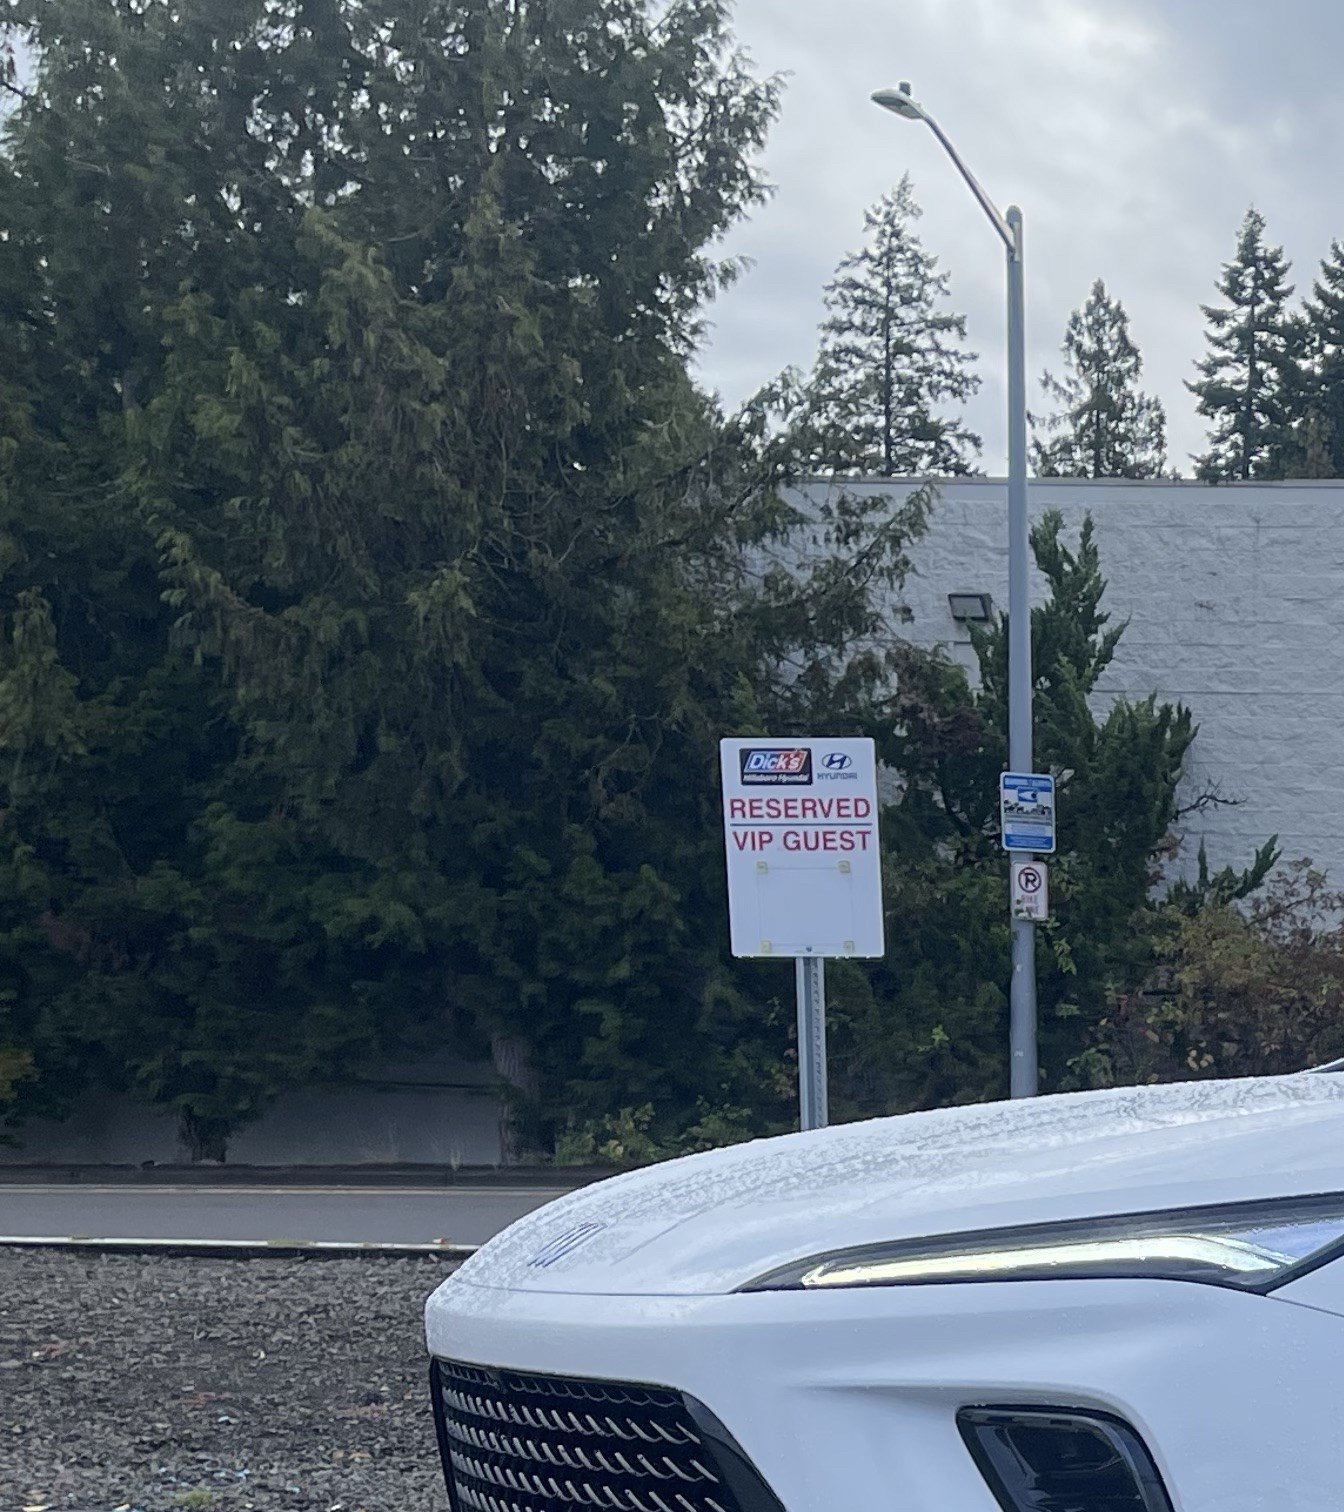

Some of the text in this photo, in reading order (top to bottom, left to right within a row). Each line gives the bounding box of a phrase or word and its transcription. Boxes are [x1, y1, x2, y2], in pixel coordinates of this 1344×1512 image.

[749, 752, 802, 771] Dick's
[816, 771, 859, 781] HYUNDAI
[729, 798, 871, 820] RESERVED
[732, 830, 873, 852] VIP GUEST
